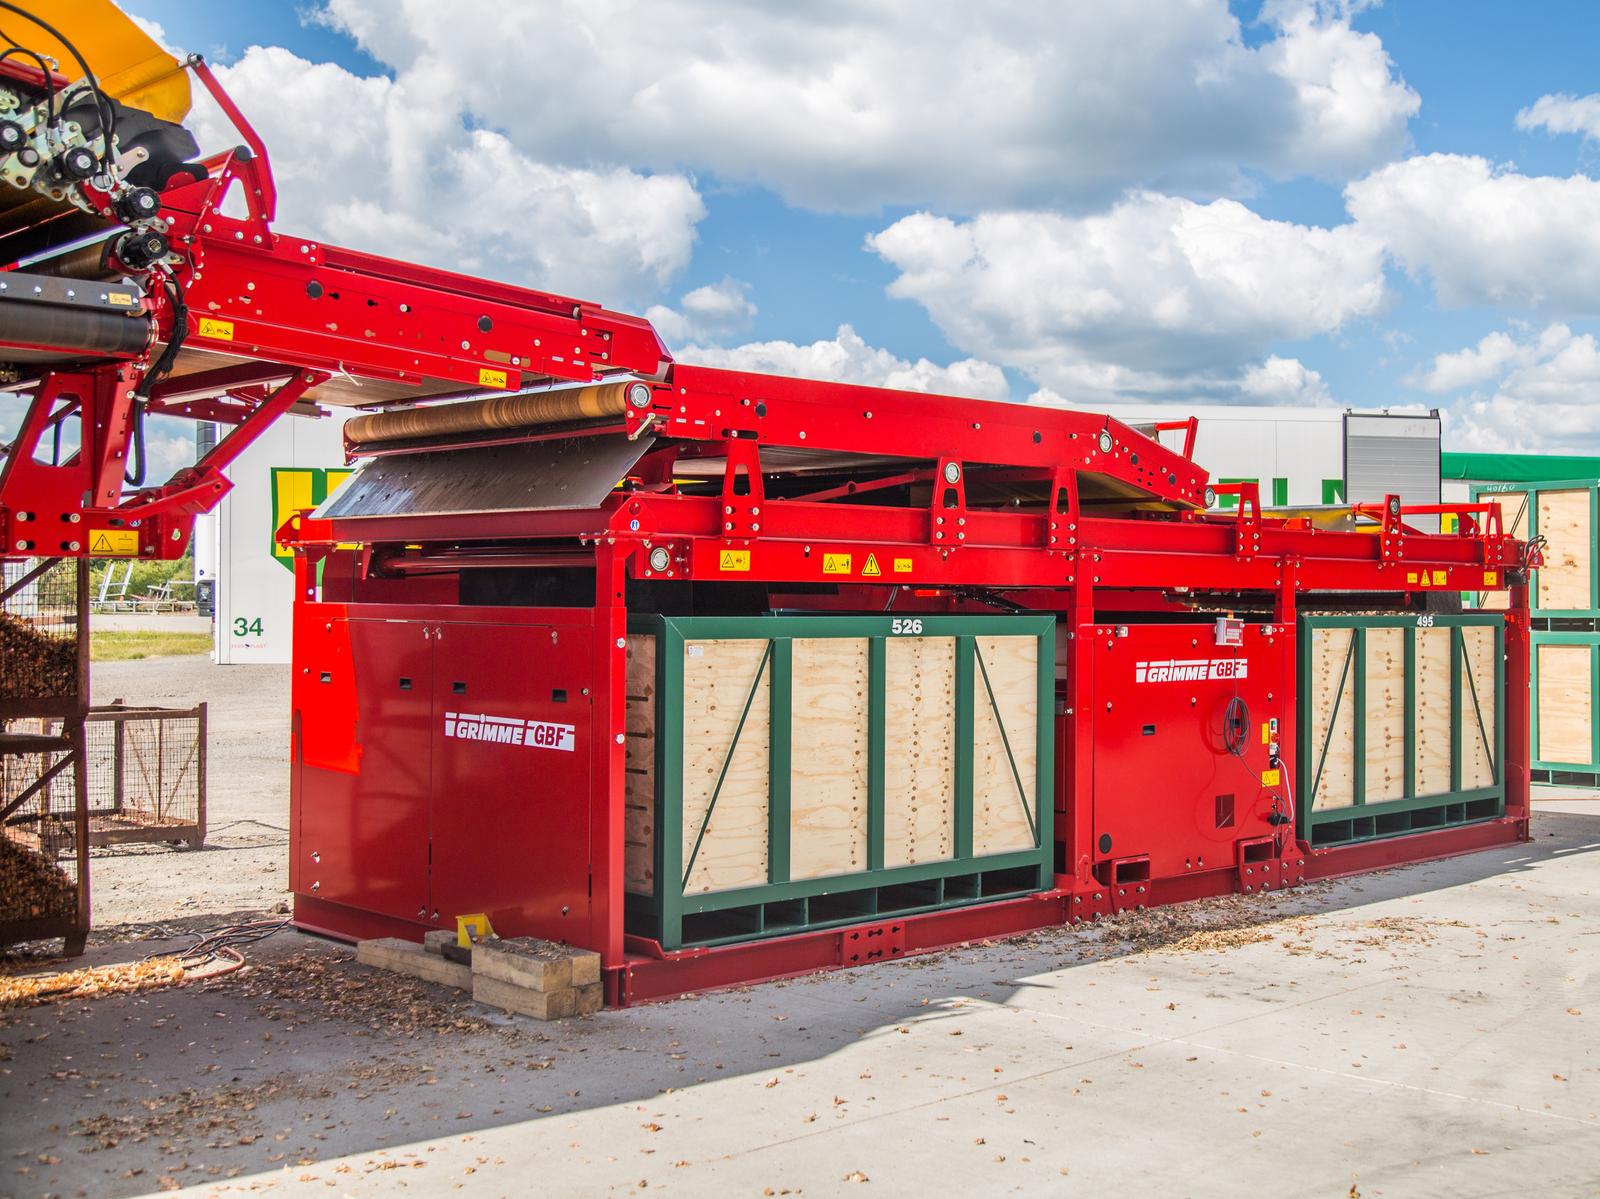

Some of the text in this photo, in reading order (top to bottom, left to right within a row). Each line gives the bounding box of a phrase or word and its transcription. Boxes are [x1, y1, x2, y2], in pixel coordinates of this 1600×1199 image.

[234, 617, 264, 637] 34
[891, 619, 923, 634] 526
[1417, 616, 1434, 627] 495
[1148, 659, 1241, 683] GRIMME GBF
[456, 713, 566, 747] GRIMME GBF
